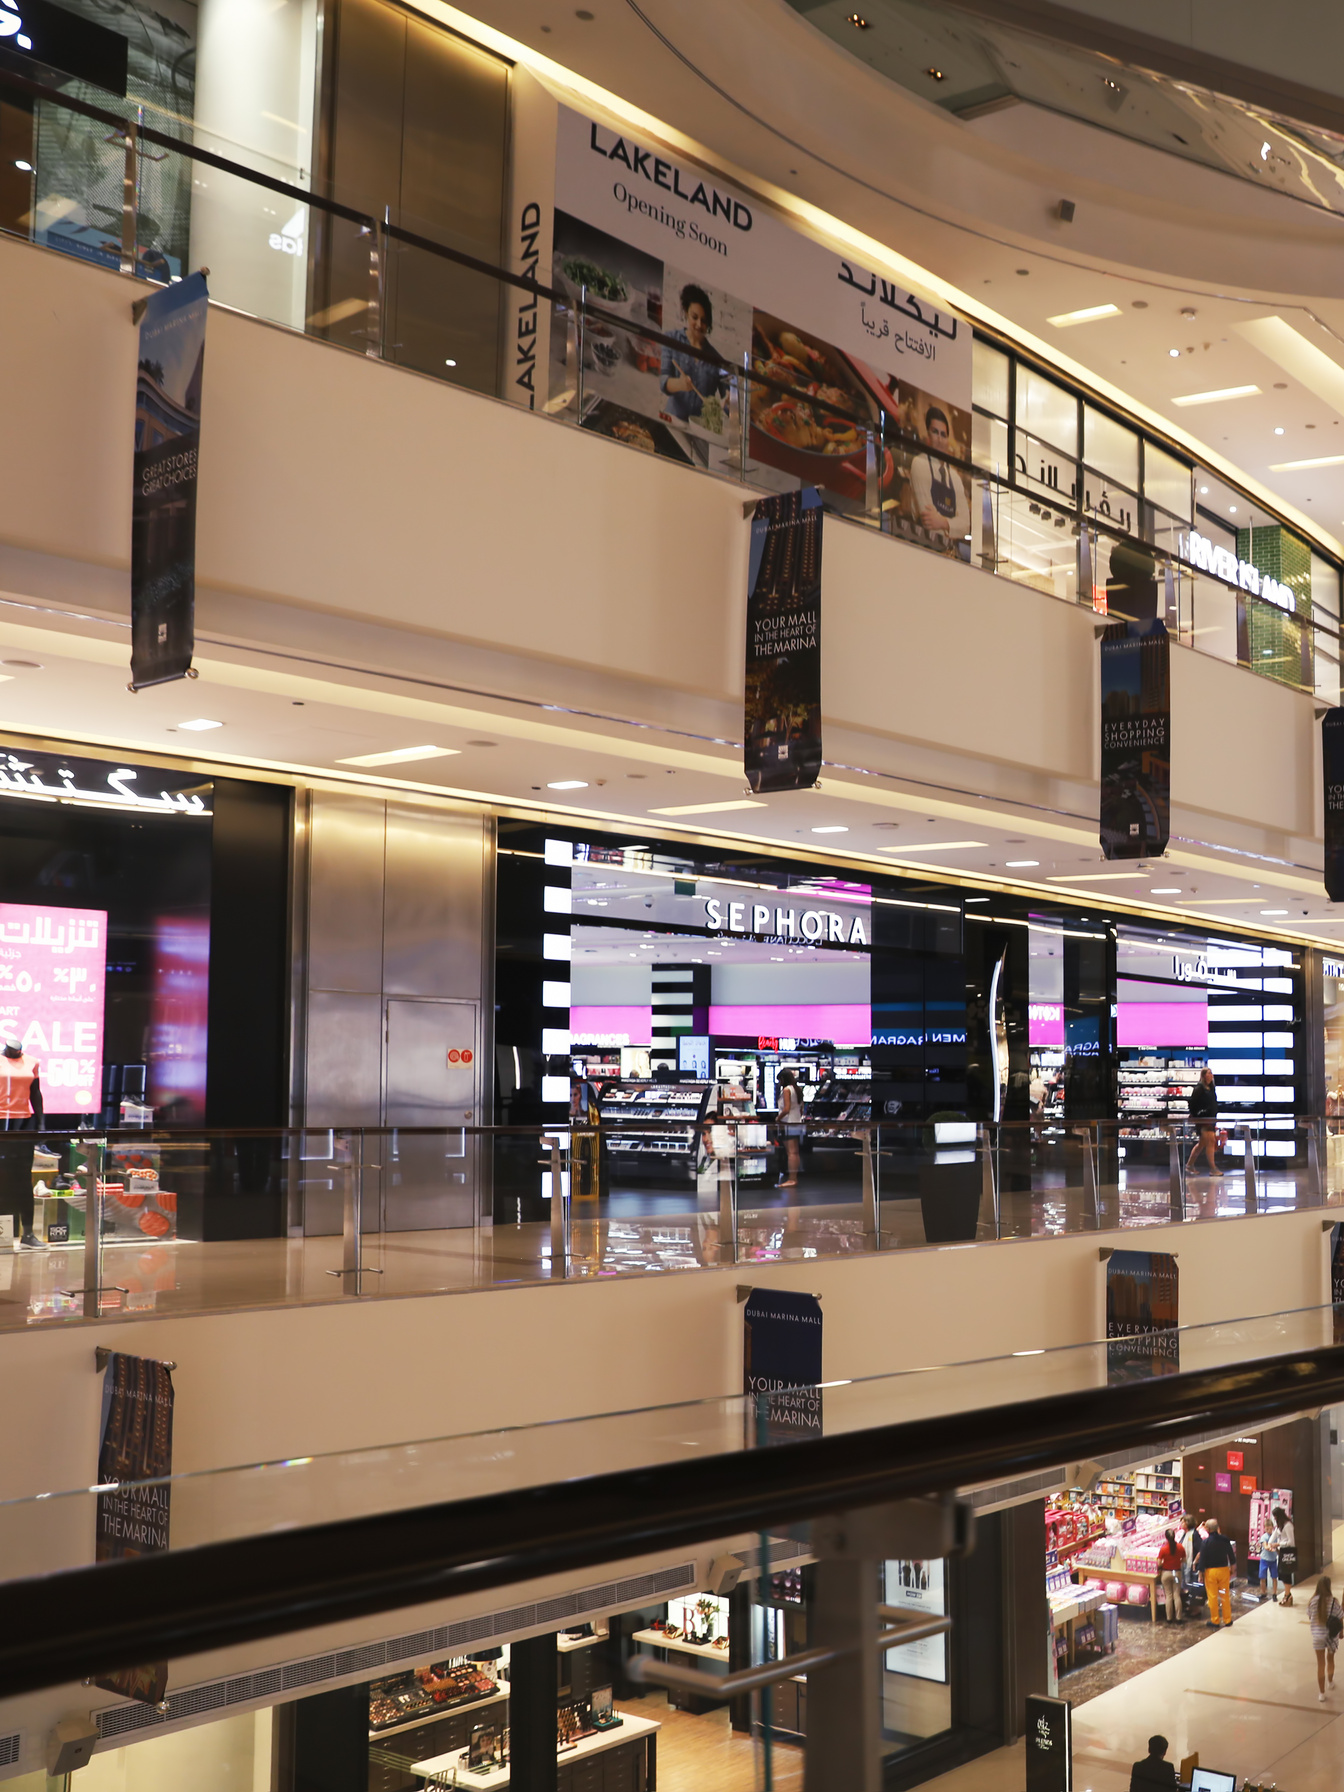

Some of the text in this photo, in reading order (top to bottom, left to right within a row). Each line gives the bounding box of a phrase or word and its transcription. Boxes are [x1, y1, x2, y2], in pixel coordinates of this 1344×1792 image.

[590, 122, 753, 232] LAKELAND
[613, 182, 728, 257] Opening Soon
[837, 260, 957, 341] ليكلاند
[894, 325, 936, 362] الافتتاح
[142, 448, 197, 483] GREAT STORES
[142, 463, 197, 497] GREAT CHOICES
[1189, 531, 1238, 586] RIVER
[755, 611, 816, 632] YOUR MALL
[754, 624, 816, 643] IN THE HEART OF
[754, 637, 816, 656] THE MARINA
[1104, 718, 1165, 732] EVERYDAY
[1104, 727, 1165, 742] SHOPPING
[1104, 737, 1165, 749] CONVENIENCE
[1328, 801, 1344, 810] THE
[705, 899, 867, 944] SEPHORA
[0, 916, 99, 954] تنزيلات
[0, 1006, 20, 1016] ART
[0, 1019, 97, 1053] SALE
[1129, 1270, 1157, 1278] MARINA
[1159, 1272, 1177, 1280] MALL
[746, 1309, 821, 1325] DUBAI MARINA MALL
[1108, 1322, 1178, 1338] EVERYDAY
[1108, 1332, 1178, 1349] SHOPPING
[1109, 1343, 1178, 1358] CONVENIENCE
[105, 1384, 172, 1407] DUBAI MARINA MALL
[749, 1375, 821, 1399] YOUR MALL
[749, 1391, 820, 1412] IN HEART OF
[770, 1409, 821, 1429] MARINA
[104, 1474, 168, 1510] YOUR MALL
[103, 1496, 168, 1526] IN THE HEART OF
[103, 1513, 168, 1550] THE MARINA
